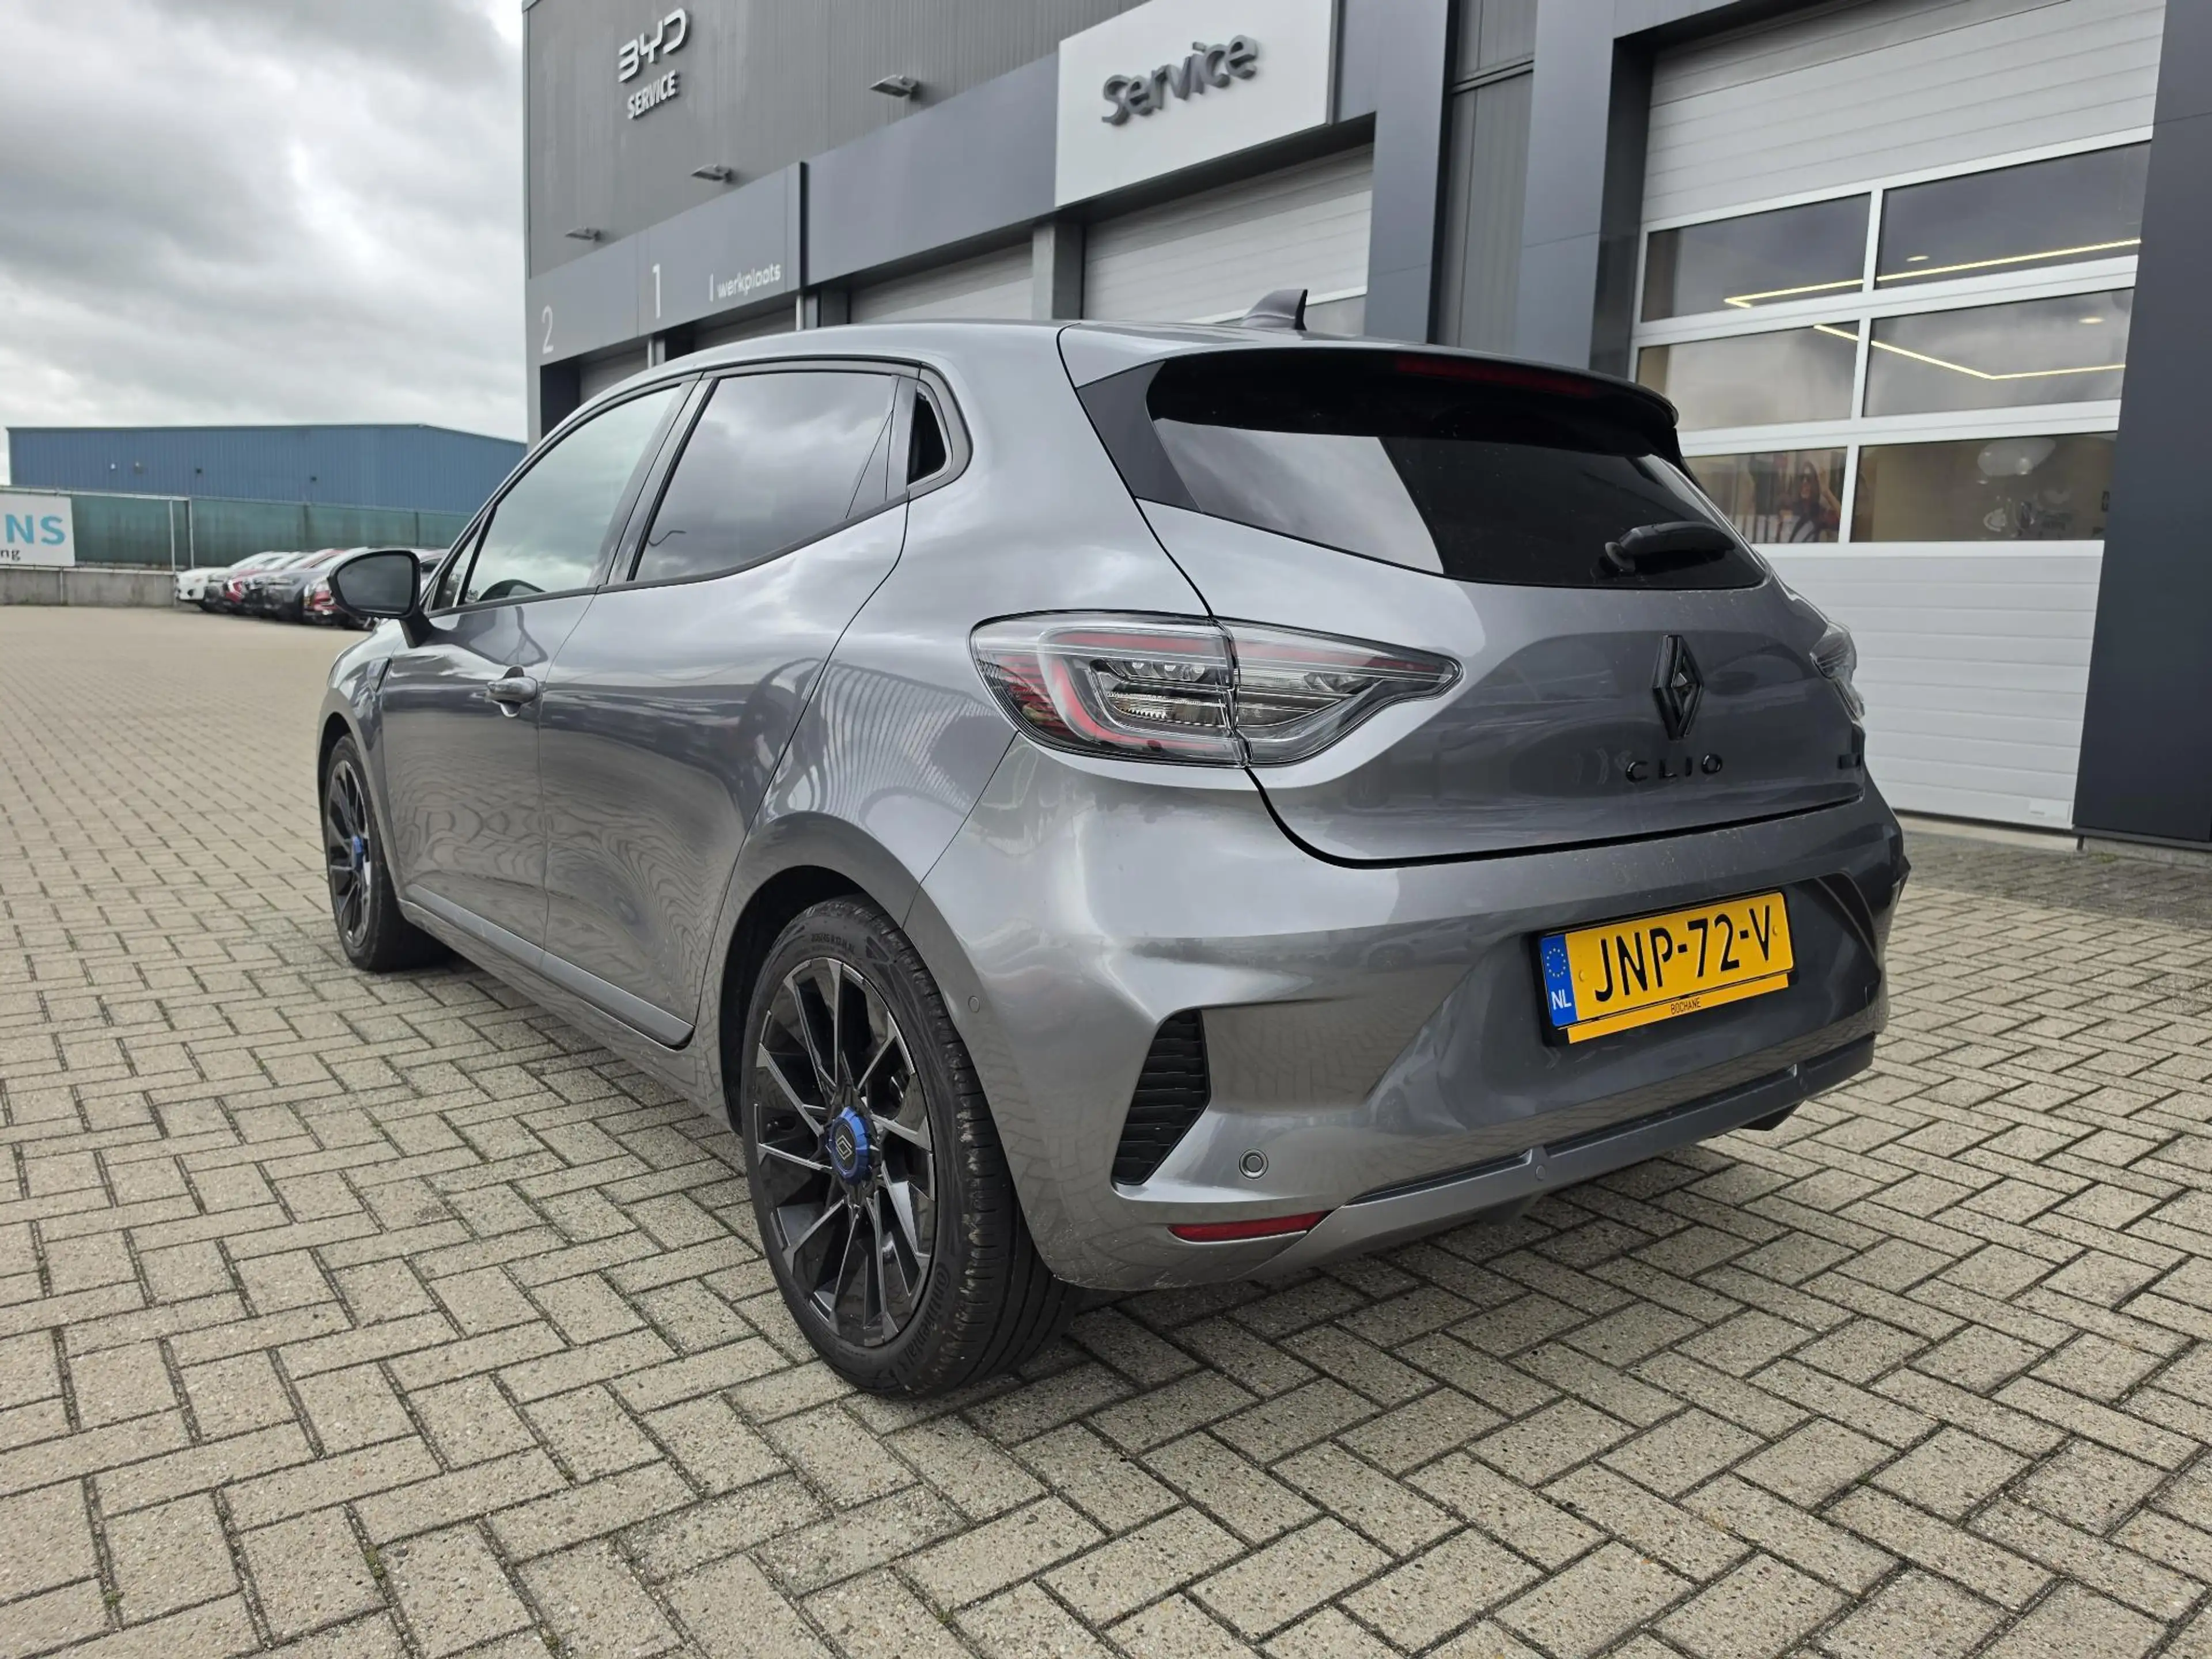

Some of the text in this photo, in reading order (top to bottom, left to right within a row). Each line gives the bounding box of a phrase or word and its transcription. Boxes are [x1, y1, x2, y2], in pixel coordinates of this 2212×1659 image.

[618, 7, 686, 82] BYD
[627, 69, 676, 119] SERVICE
[1102, 35, 1257, 125] Service
[652, 263, 661, 319] 1
[717, 263, 781, 298] werkplaats
[543, 305, 554, 354] 2
[5, 514, 66, 546] NS
[0, 549, 21, 562] ng
[1625, 753, 1723, 783] CLIO
[1594, 905, 1770, 1002] JNP-72-V
[1551, 989, 1572, 1010] NL
[1671, 997, 1701, 1015] BOCHANE
